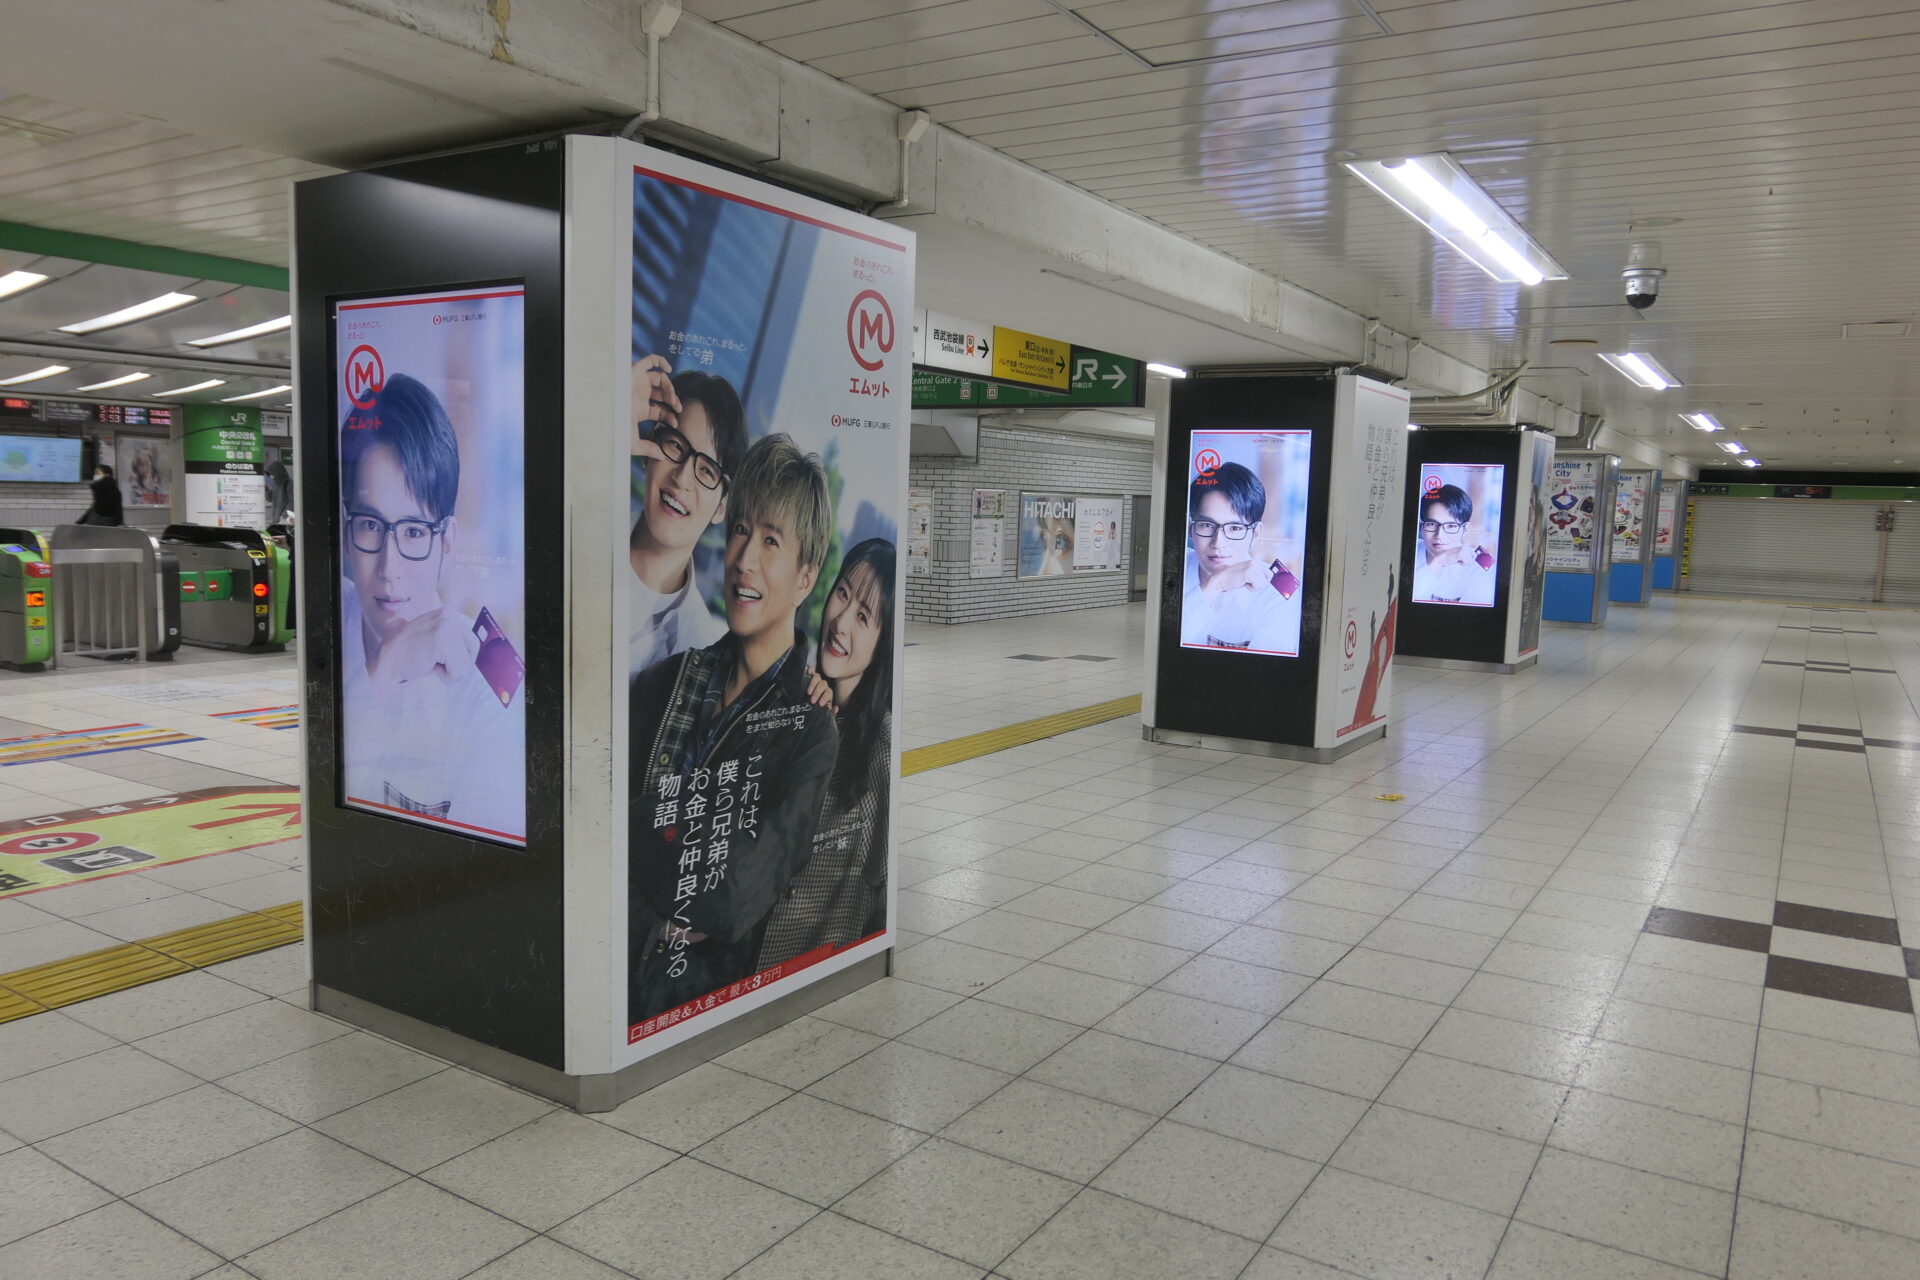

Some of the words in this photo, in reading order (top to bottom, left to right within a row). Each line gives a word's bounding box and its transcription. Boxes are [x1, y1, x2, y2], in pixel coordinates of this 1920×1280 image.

[933, 328, 964, 345] 西武池袋線
[668, 343, 714, 366] をしてる弟
[942, 343, 954, 353] Seibu
[955, 346, 965, 355] Line
[1072, 358, 1098, 381] JR
[848, 377, 890, 399] エムット
[911, 376, 933, 385] entral
[935, 376, 952, 385] Gate
[231, 413, 247, 422] JR
[346, 416, 383, 430] エムット
[842, 417, 861, 428] MUFG
[1553, 460, 1581, 470] unshine
[1024, 501, 1075, 519] HITACHI
[653, 772, 682, 829] 物語
[738, 751, 763, 839] これは、
[703, 758, 740, 893] 僕ら兄弟が
[666, 767, 711, 978] お金と仲良くなる
[630, 990, 728, 1041] 口座開設&入金で
[729, 965, 783, 999] 最大3万円
